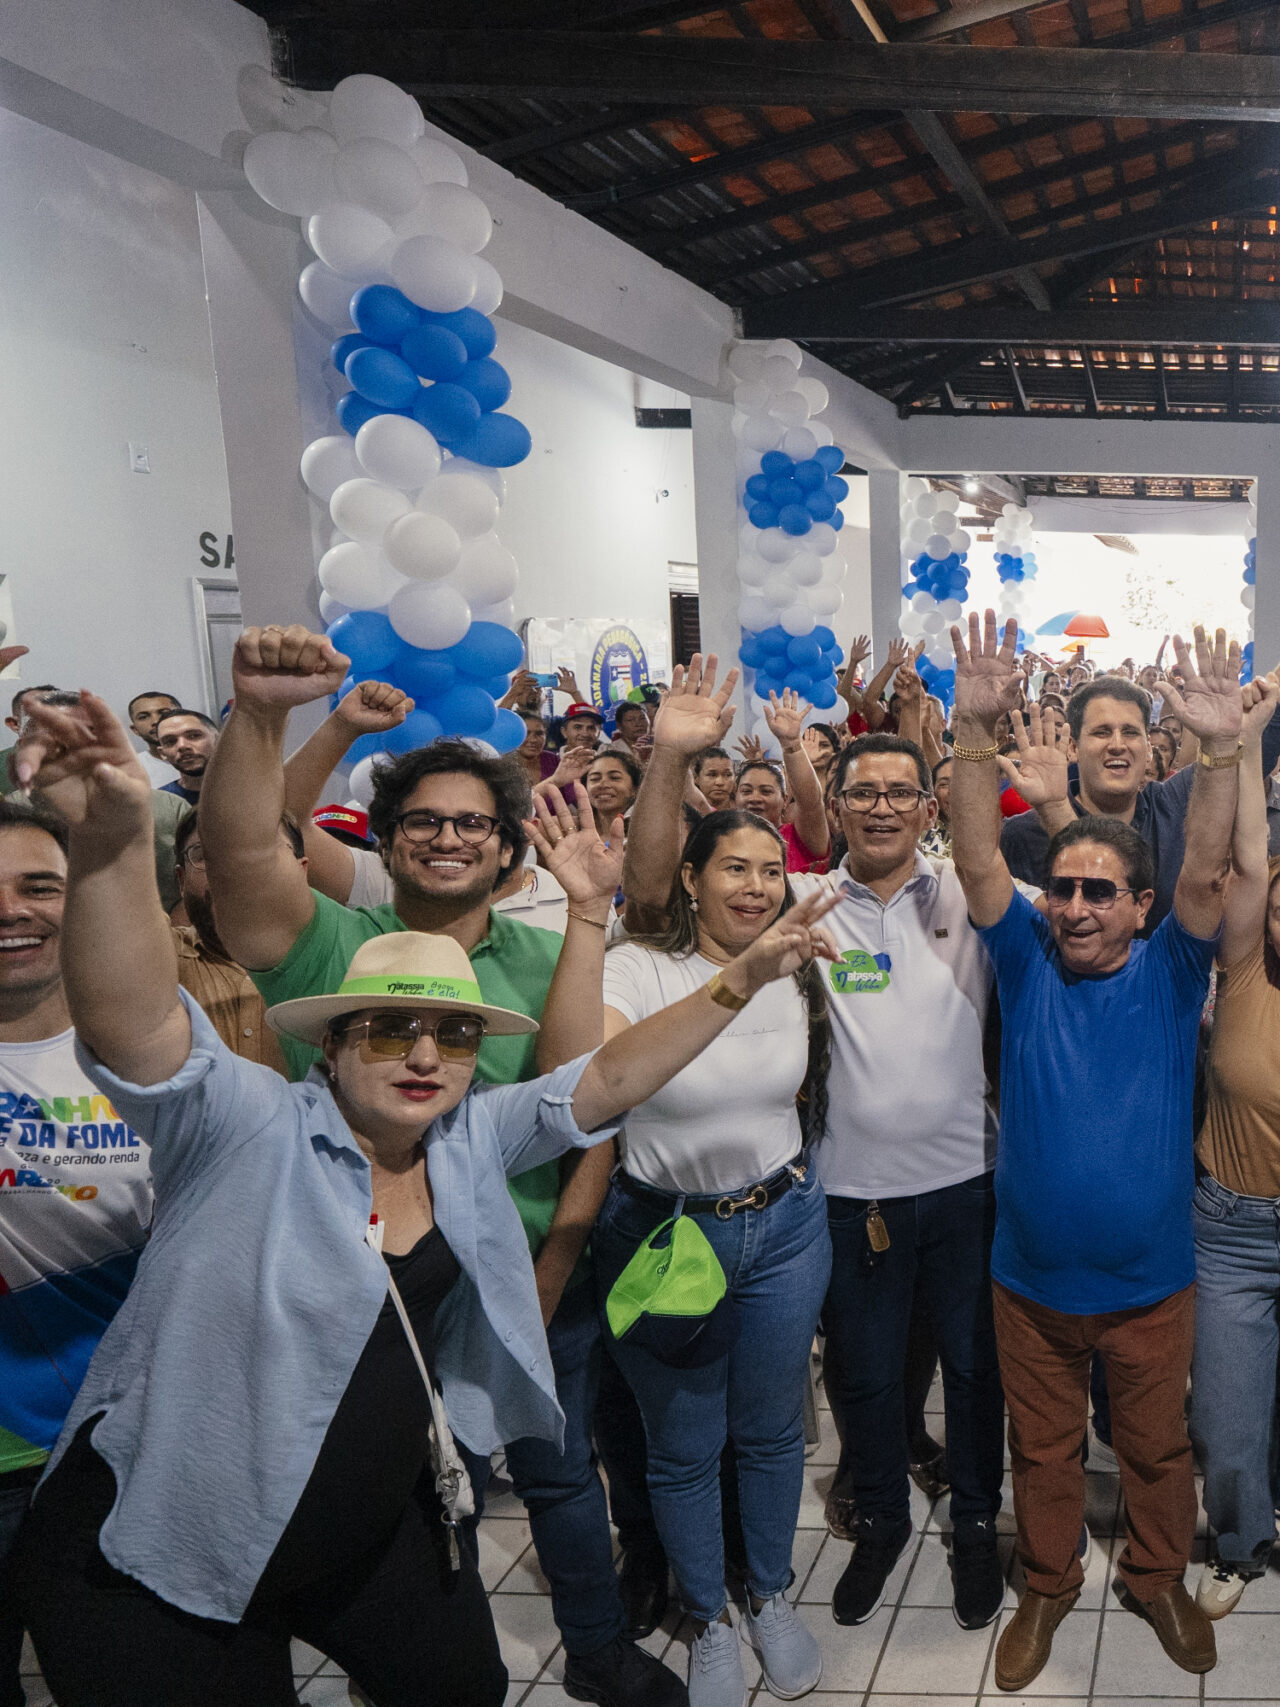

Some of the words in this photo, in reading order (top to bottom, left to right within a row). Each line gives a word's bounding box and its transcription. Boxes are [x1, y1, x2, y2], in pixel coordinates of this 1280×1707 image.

[18, 1122, 56, 1149] DA
[66, 1122, 140, 1149] FOME
[54, 1153, 107, 1167] gerando
[109, 1151, 140, 1164] renda
